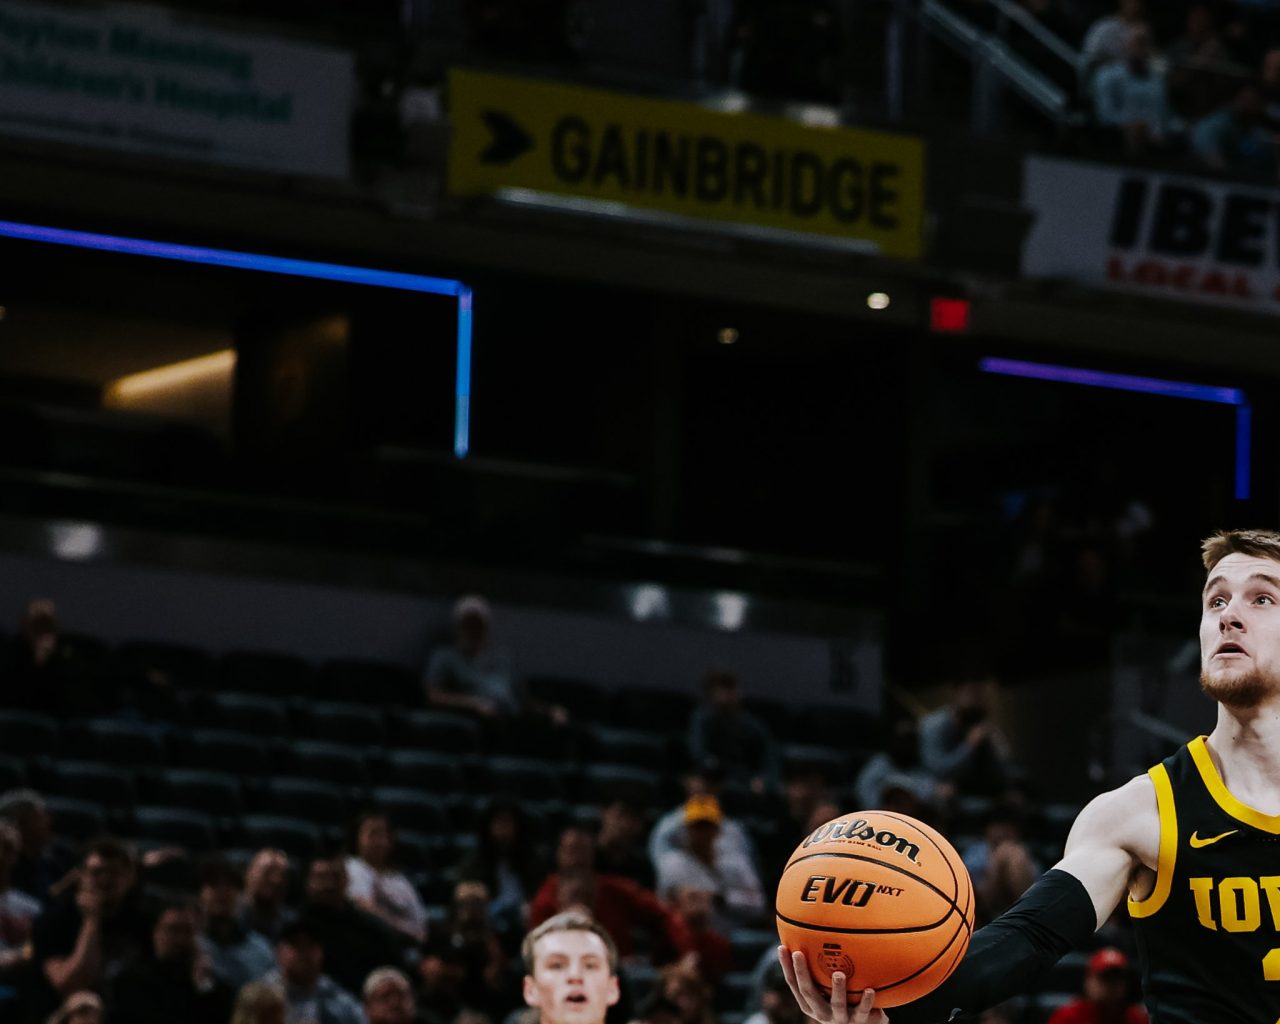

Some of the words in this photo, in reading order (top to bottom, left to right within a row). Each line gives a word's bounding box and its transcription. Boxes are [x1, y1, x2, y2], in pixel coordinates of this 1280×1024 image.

[550, 116, 898, 229] GAINBRIDGE
[1107, 257, 1251, 298] LOCAL
[802, 820, 921, 864] Wilson
[800, 875, 876, 908] EVO
[876, 885, 904, 897] NXT
